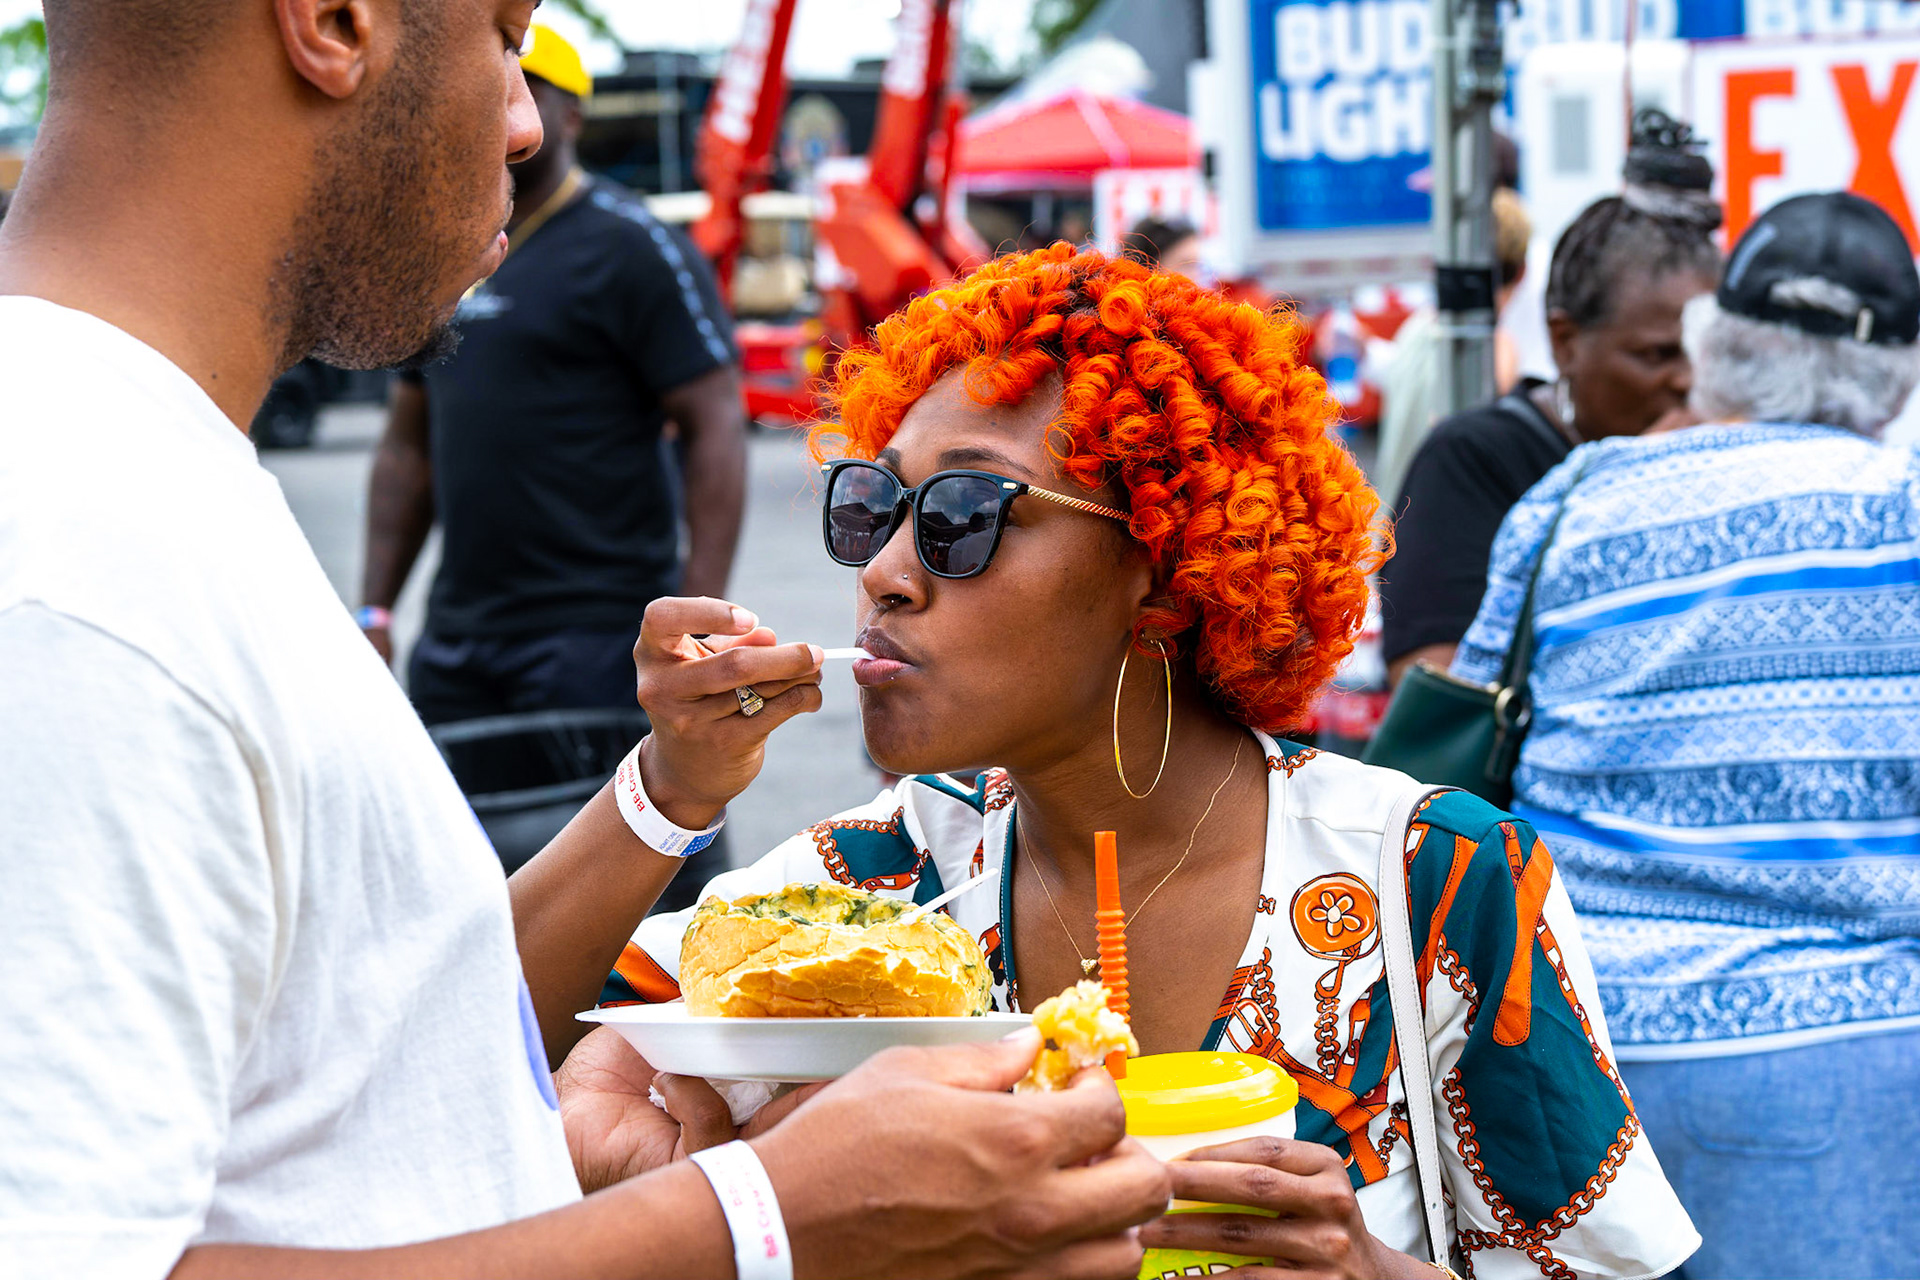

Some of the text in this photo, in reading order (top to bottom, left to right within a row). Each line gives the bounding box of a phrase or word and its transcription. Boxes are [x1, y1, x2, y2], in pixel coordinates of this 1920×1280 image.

[1274, 2, 1431, 77] BUD
[1259, 79, 1430, 162] LIGH
[632, 793, 646, 812] BB
